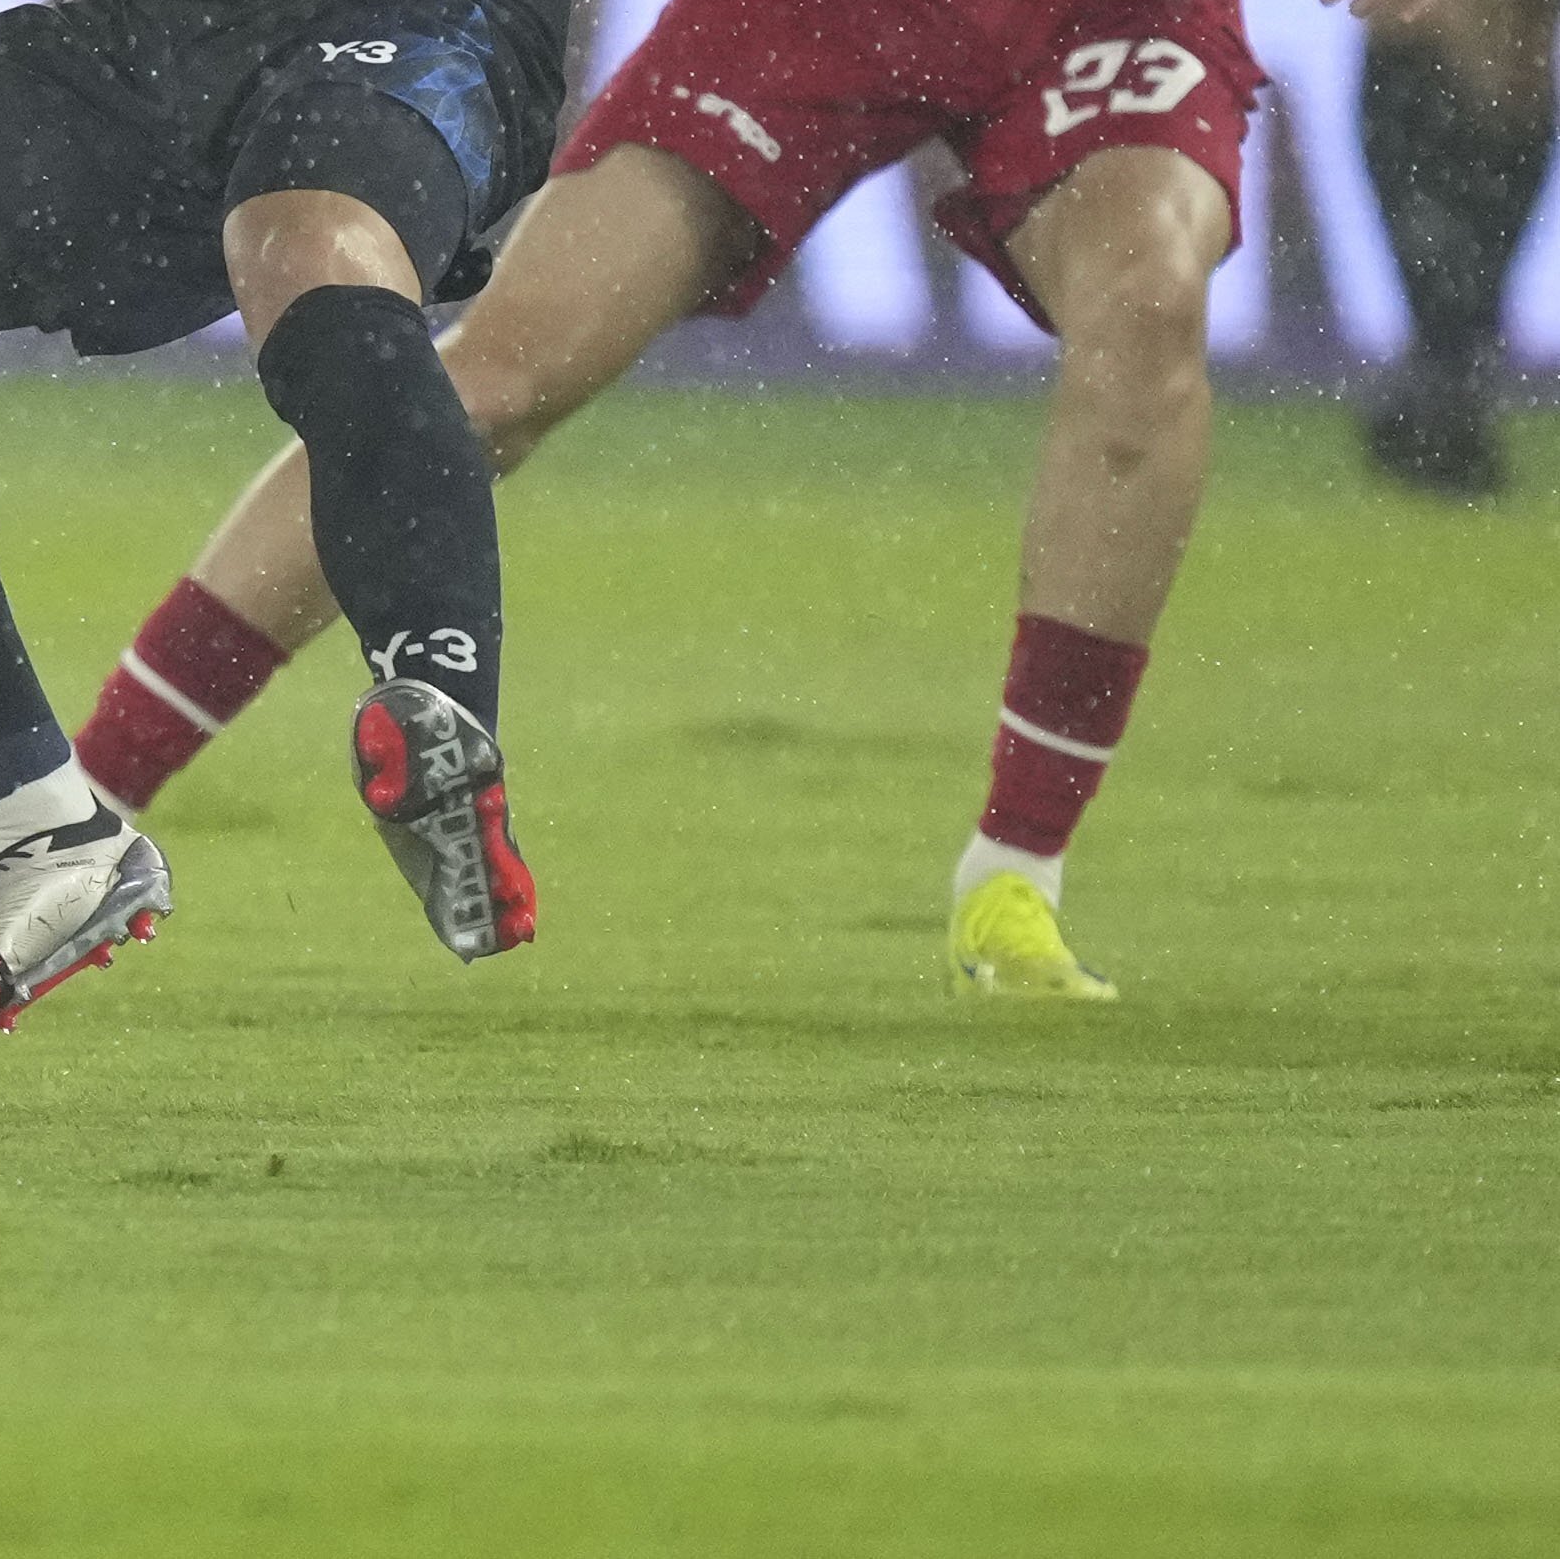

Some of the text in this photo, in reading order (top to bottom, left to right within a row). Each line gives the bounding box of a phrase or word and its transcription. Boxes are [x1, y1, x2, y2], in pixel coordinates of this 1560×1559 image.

[318, 40, 398, 64] Y-3
[1042, 38, 1207, 138] 23
[371, 628, 478, 682] Y-3
[55, 858, 96, 869] MINAMINO
